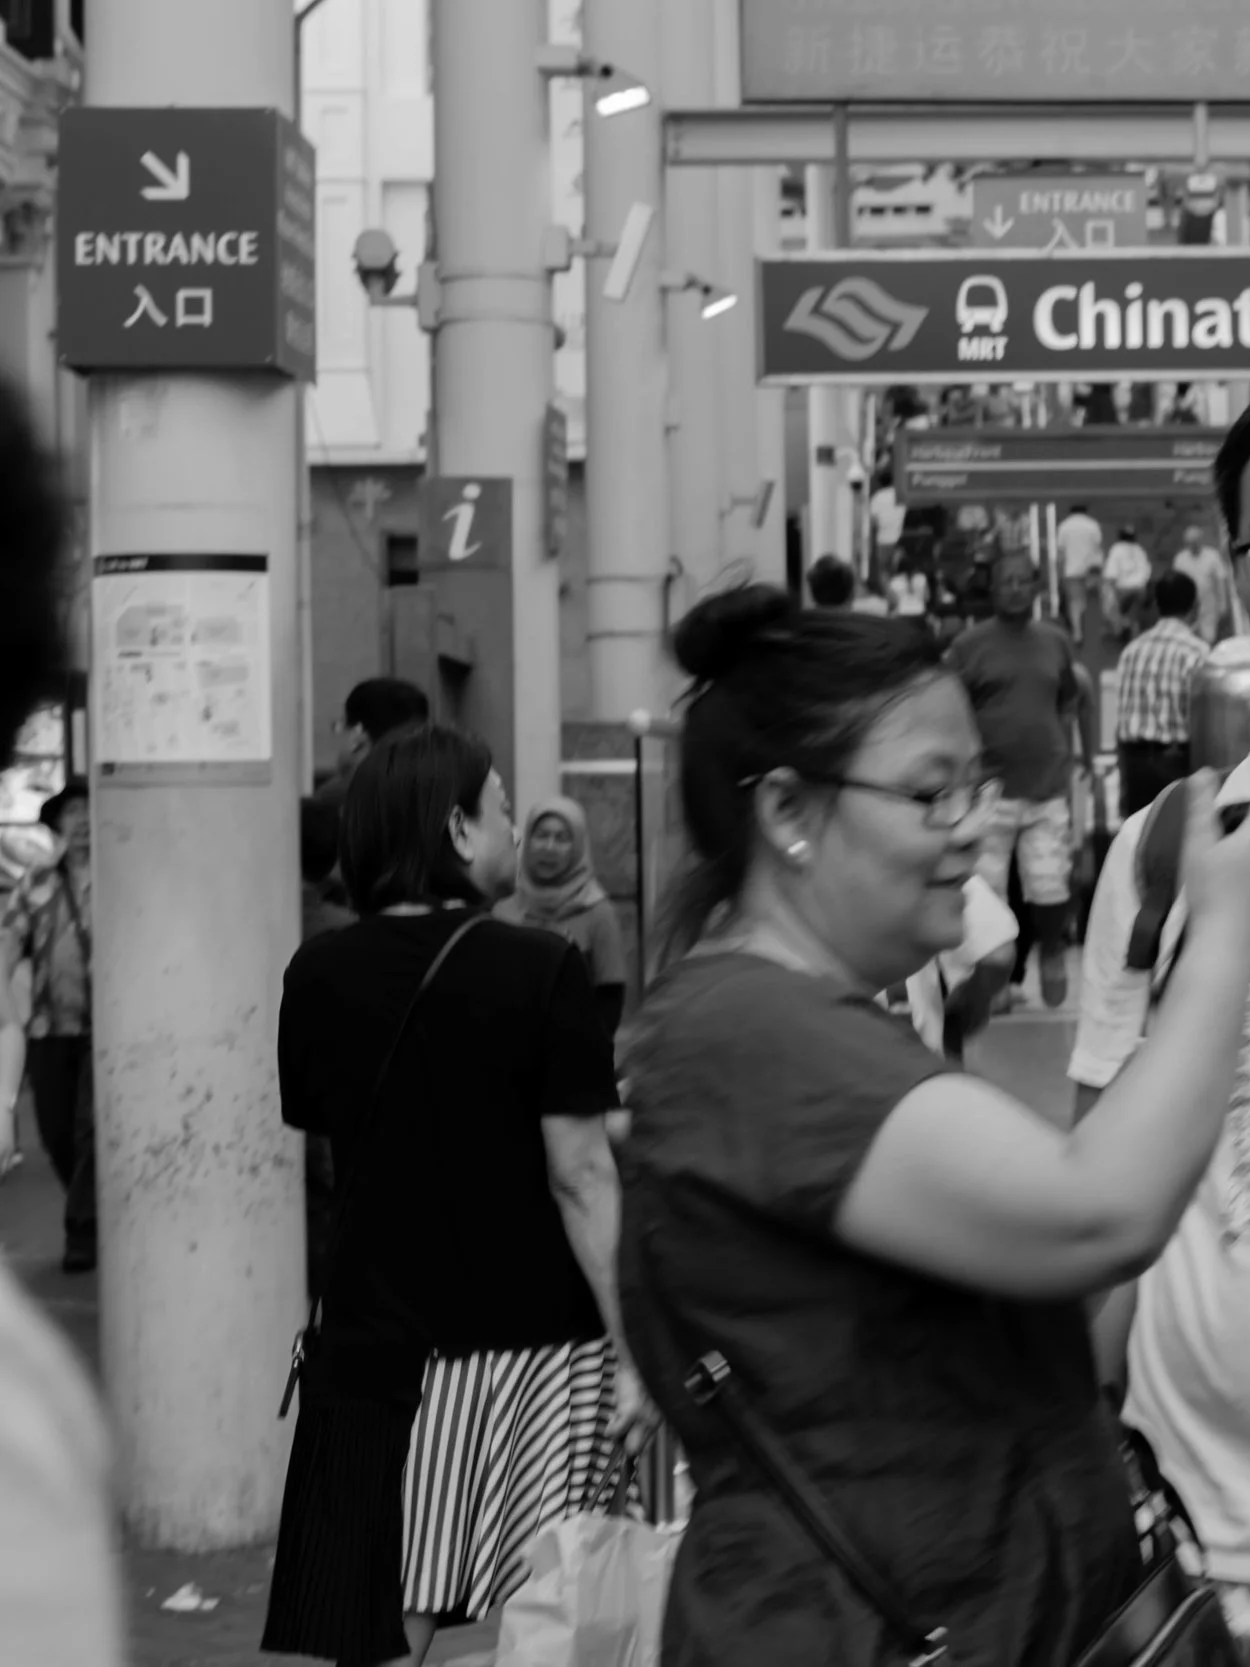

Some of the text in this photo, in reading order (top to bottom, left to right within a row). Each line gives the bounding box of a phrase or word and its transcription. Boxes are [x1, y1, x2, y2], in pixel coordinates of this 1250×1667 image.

[1019, 189, 1136, 215] ENTRANCE
[74, 231, 260, 266] ENTRANCE
[1045, 218, 1116, 251] 入口
[123, 285, 214, 329] 入口
[958, 337, 1009, 361] MRT
